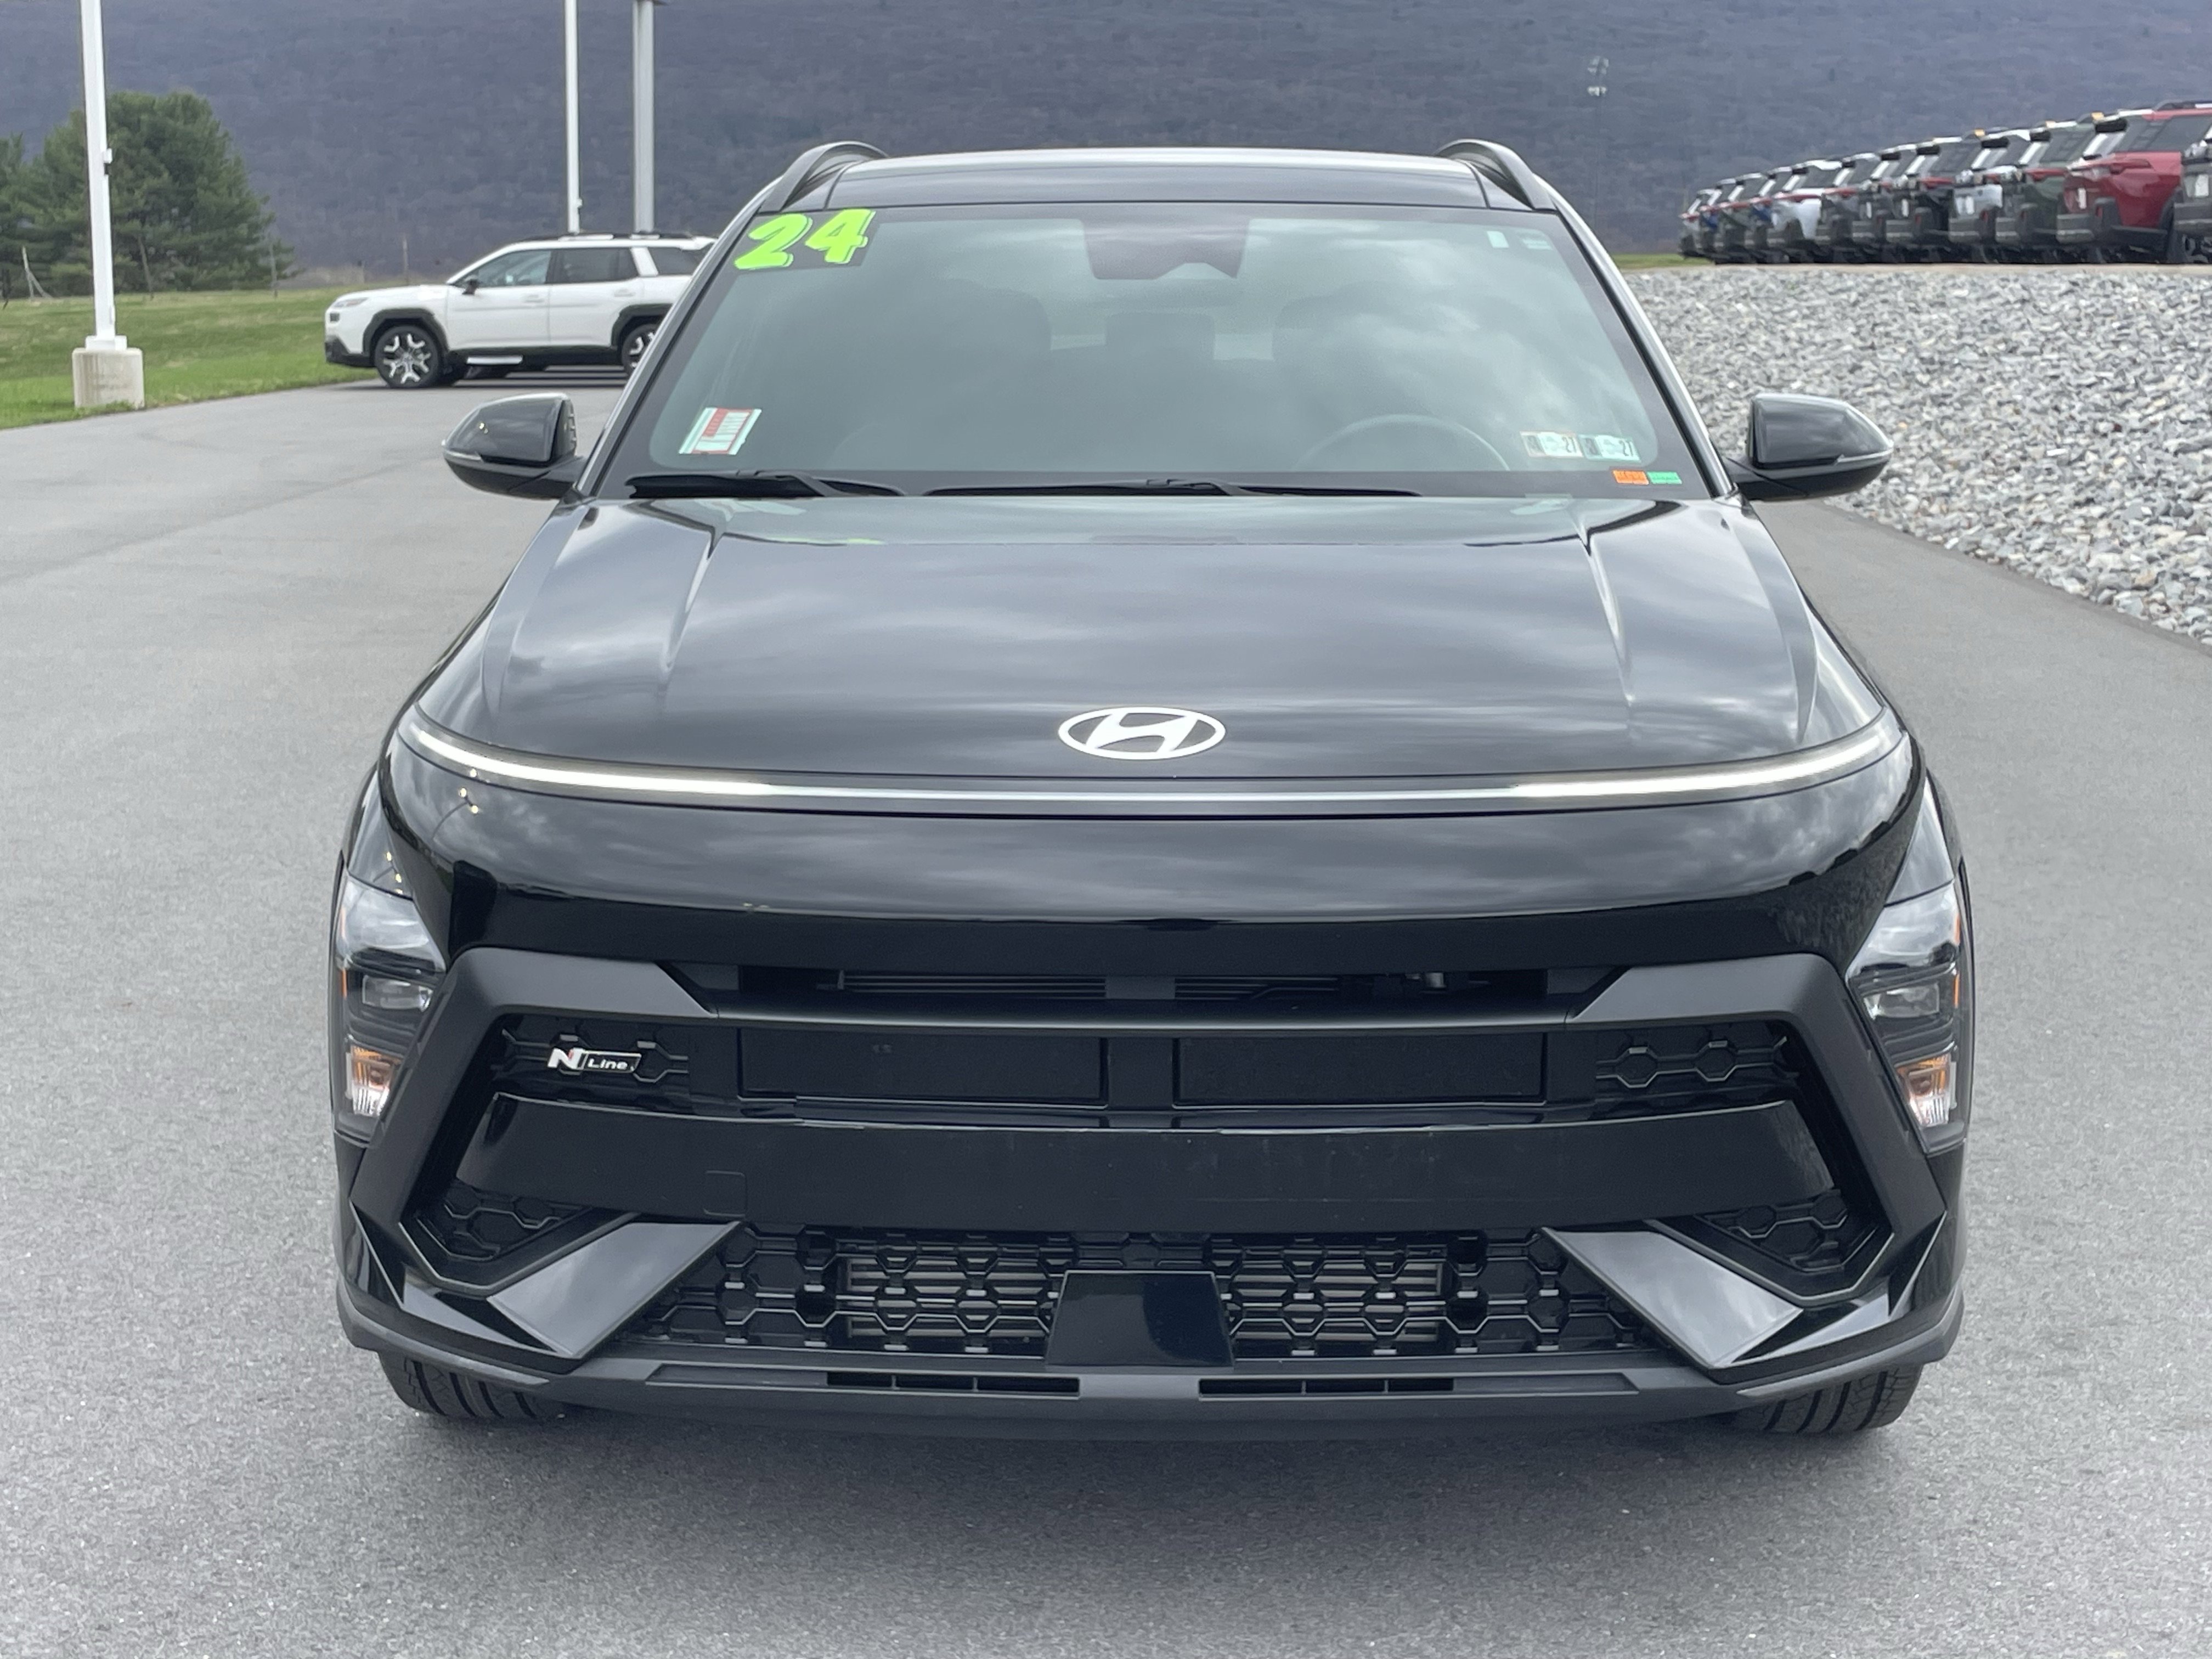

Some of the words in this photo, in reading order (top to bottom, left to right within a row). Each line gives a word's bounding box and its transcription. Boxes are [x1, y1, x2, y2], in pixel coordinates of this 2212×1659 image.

[734, 208, 876, 270] 24
[548, 1047, 584, 1070] N
[588, 1058, 629, 1070] Line
